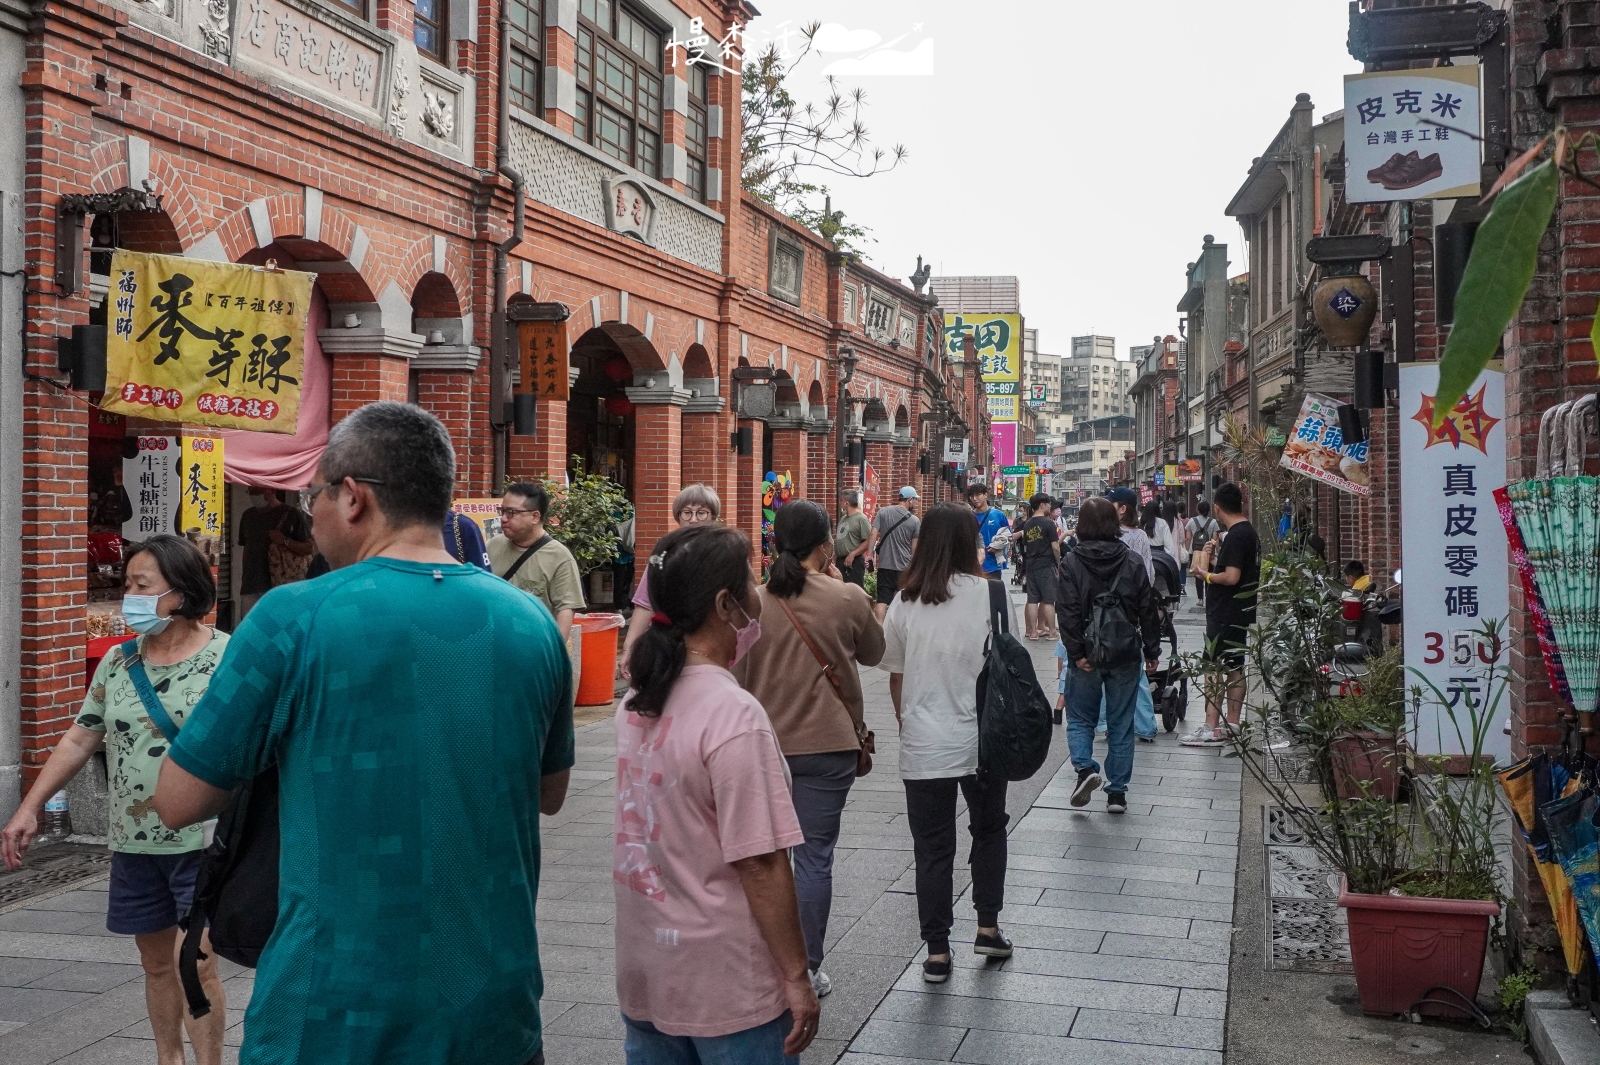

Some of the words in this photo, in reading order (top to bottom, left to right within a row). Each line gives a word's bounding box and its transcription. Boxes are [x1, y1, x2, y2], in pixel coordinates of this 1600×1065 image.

[1356, 90, 1462, 125] 皮克米
[1366, 127, 1450, 145] 台灣手工鞋
[116, 270, 138, 342] 福州師
[1337, 296, 1357, 312] 染
[136, 273, 299, 394] 麥芽酥
[945, 316, 1010, 352] 吉田
[123, 384, 180, 408] 手工現作
[184, 462, 220, 532] 麥芽酥
[1442, 463, 1479, 618] 真皮零碼
